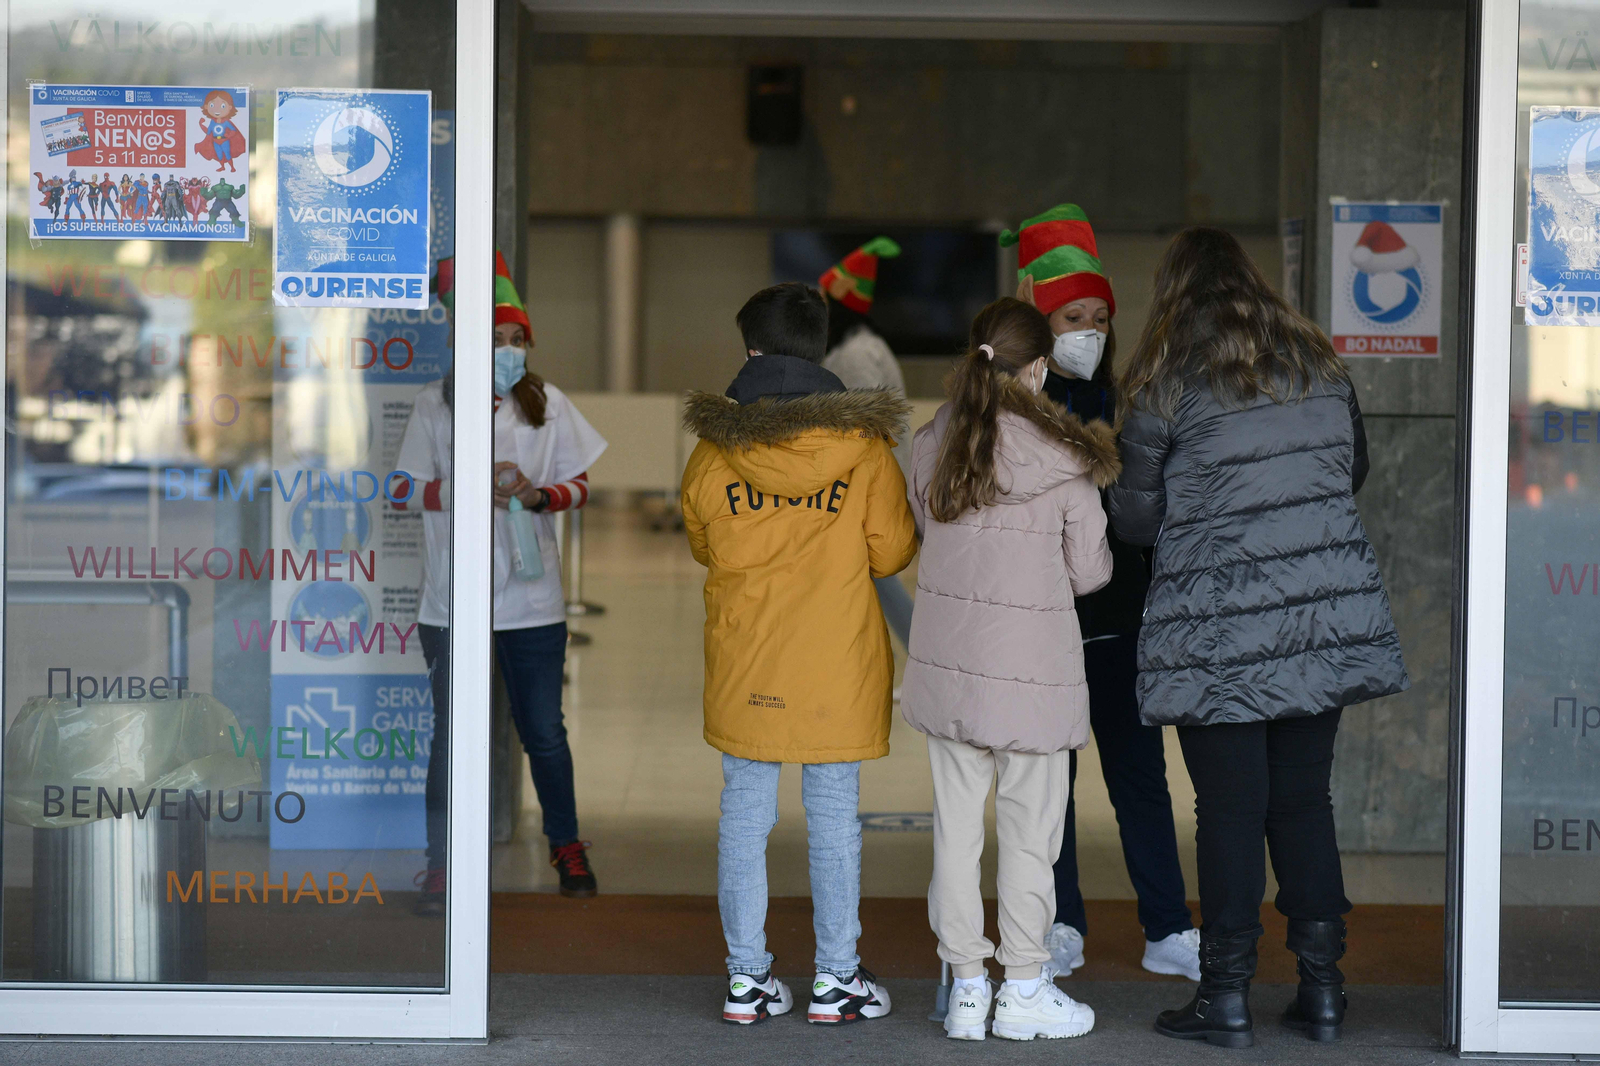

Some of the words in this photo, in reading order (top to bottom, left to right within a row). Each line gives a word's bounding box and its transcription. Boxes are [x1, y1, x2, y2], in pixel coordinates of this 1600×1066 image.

[49, 13, 342, 57] VÄLKOMMEN
[52, 88, 97, 96] VACINACIÓN
[94, 110, 175, 127] Benvidos
[94, 128, 176, 150] NEN@S
[94, 151, 104, 164] 5
[108, 154, 117, 164] a
[121, 151, 135, 164] 11
[139, 154, 176, 164] anos
[288, 204, 418, 224] VACINACIÓN
[70, 222, 146, 233] SUPERHEROES
[148, 220, 236, 234] VACINÁMONOS!!
[326, 227, 380, 242] COVID
[307, 252, 341, 262] XUNTA
[343, 253, 356, 262] DE
[358, 253, 397, 262] GALICIA
[46, 264, 267, 301] WELCOME
[1559, 271, 1592, 280] XUNTA
[281, 276, 423, 299] OURENSE
[1531, 295, 1600, 317] OUR
[150, 333, 414, 371] BIENVENIDO
[1345, 338, 1368, 351] BO
[1371, 338, 1425, 352] NADAL
[48, 389, 241, 427] BENVIDO
[1543, 411, 1600, 444] BE
[165, 467, 415, 504] BEM-VINDO
[67, 545, 375, 582] WILLKOMMEN
[233, 618, 418, 655] WITAMY
[47, 667, 189, 708] Привет
[229, 725, 416, 761] WELKON
[322, 764, 386, 779] Sanitaria
[389, 765, 407, 779] de
[410, 765, 428, 779] Ou
[383, 782, 399, 795] de
[43, 784, 306, 824] BENVENUTO
[166, 869, 385, 905] MERHABA
[1053, 999, 1062, 1008] FILA
